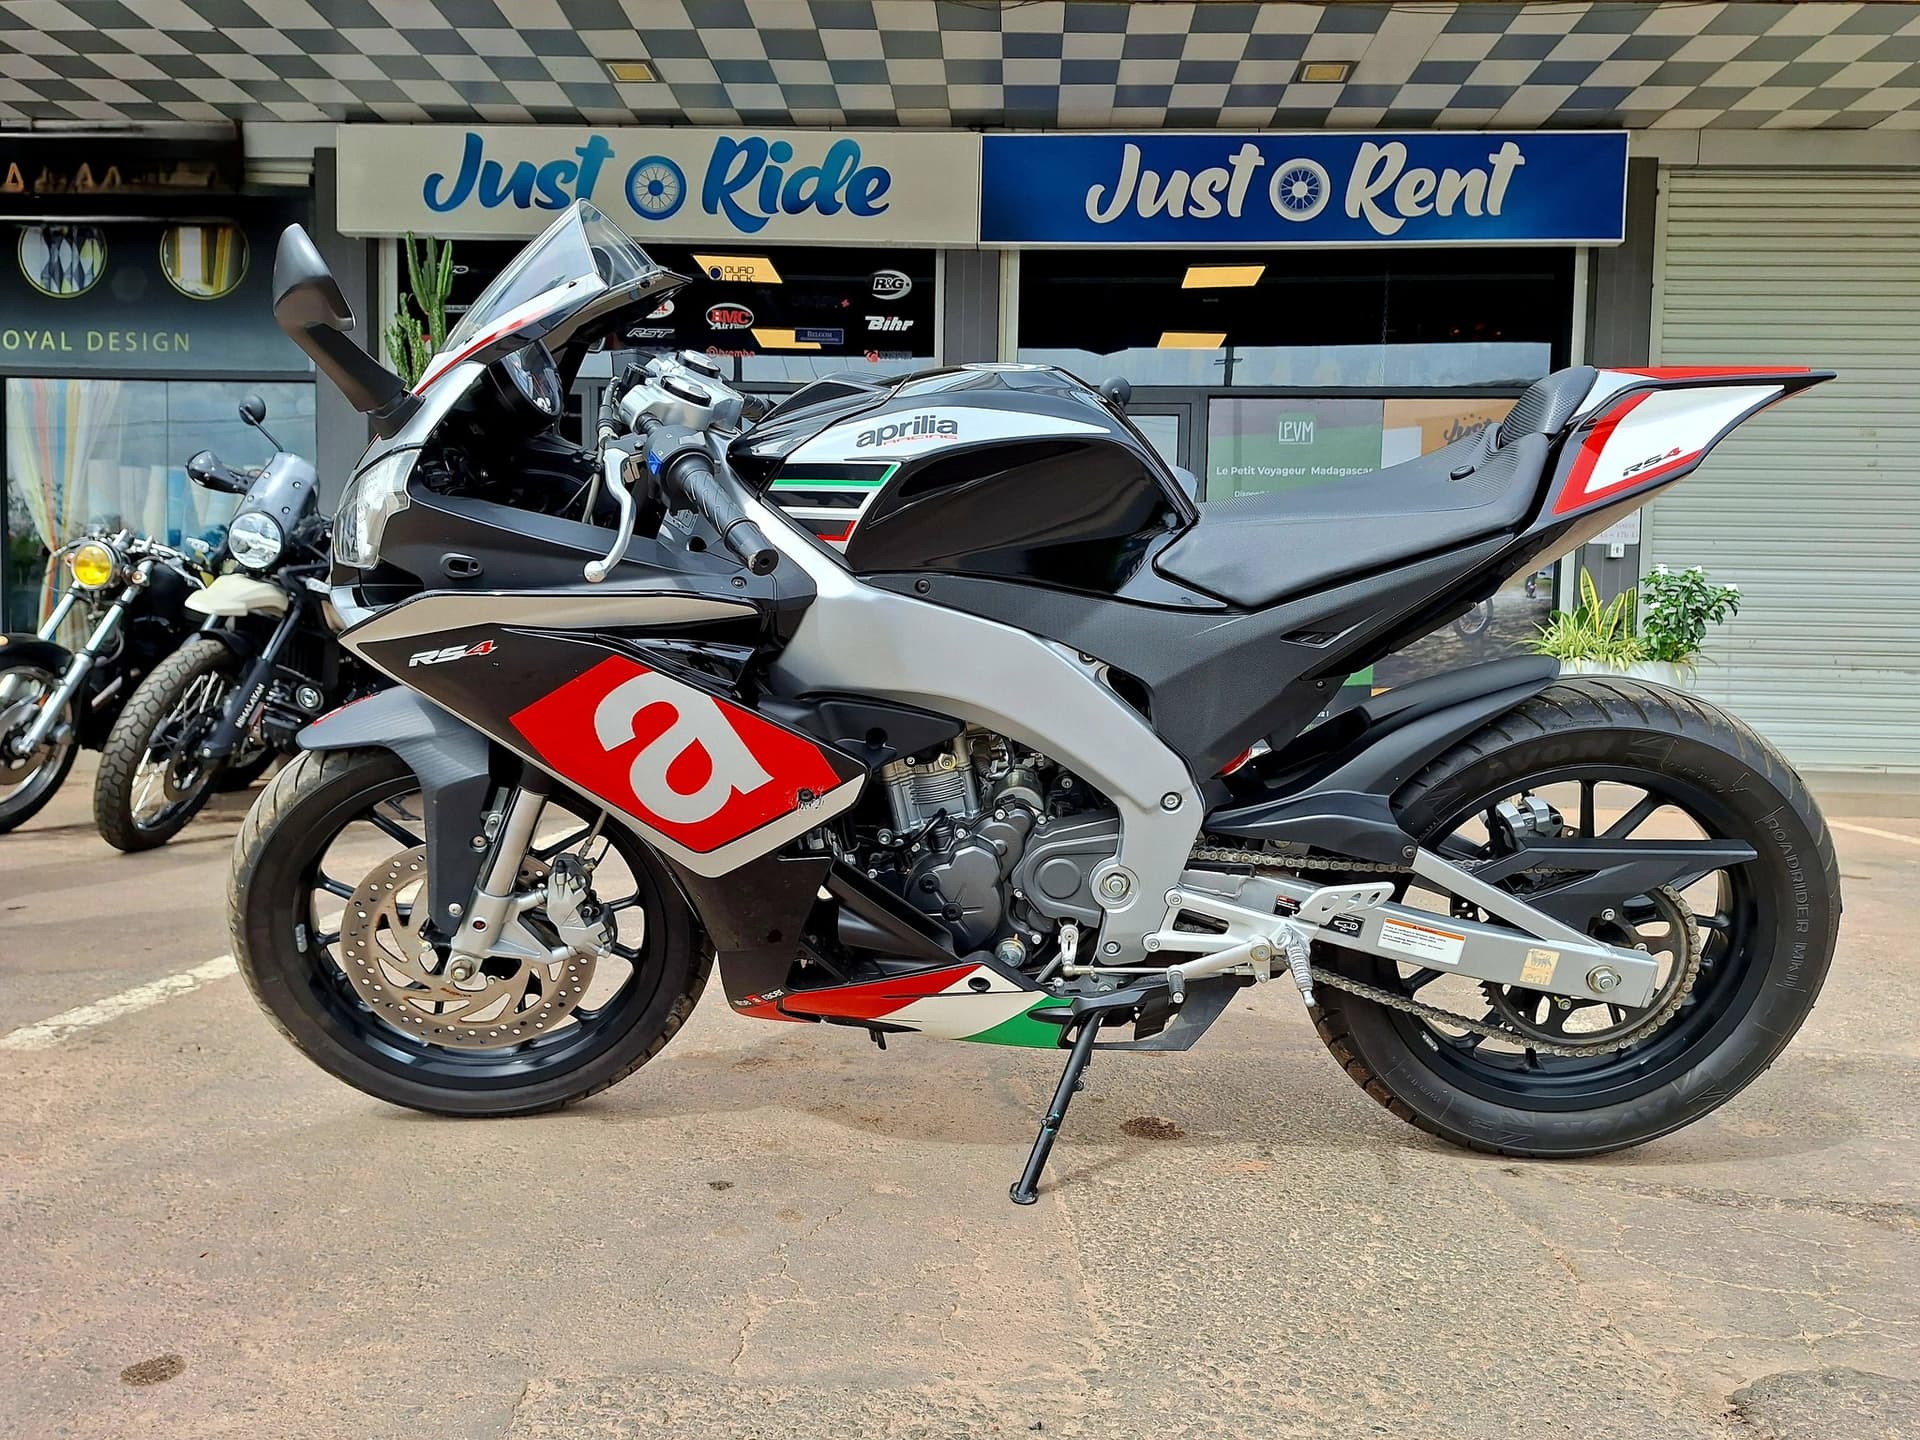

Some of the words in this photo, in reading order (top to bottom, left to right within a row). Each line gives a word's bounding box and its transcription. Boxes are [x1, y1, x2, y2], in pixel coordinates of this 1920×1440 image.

[423, 132, 615, 213] Just
[702, 136, 891, 234] Ride
[1085, 143, 1265, 224] Just
[1345, 142, 1525, 236] Rent
[724, 266, 755, 274] QUAD
[873, 277, 905, 290] R&G
[711, 309, 751, 324] BMC
[865, 315, 914, 331] Bihr
[2, 329, 73, 351] OYAL
[87, 331, 190, 352] DESIGN
[626, 327, 676, 338] RST
[856, 415, 958, 447] aprilia
[1278, 421, 1313, 443] LPVM
[1216, 466, 1229, 476] Le
[1231, 465, 1256, 476] Petit
[1257, 466, 1306, 478] Voyageur
[1622, 447, 1683, 476] RS4
[408, 639, 498, 667] RS4
[235, 682, 265, 728] HIMALAYAN
[1763, 817, 1810, 934] ROADRIDER
